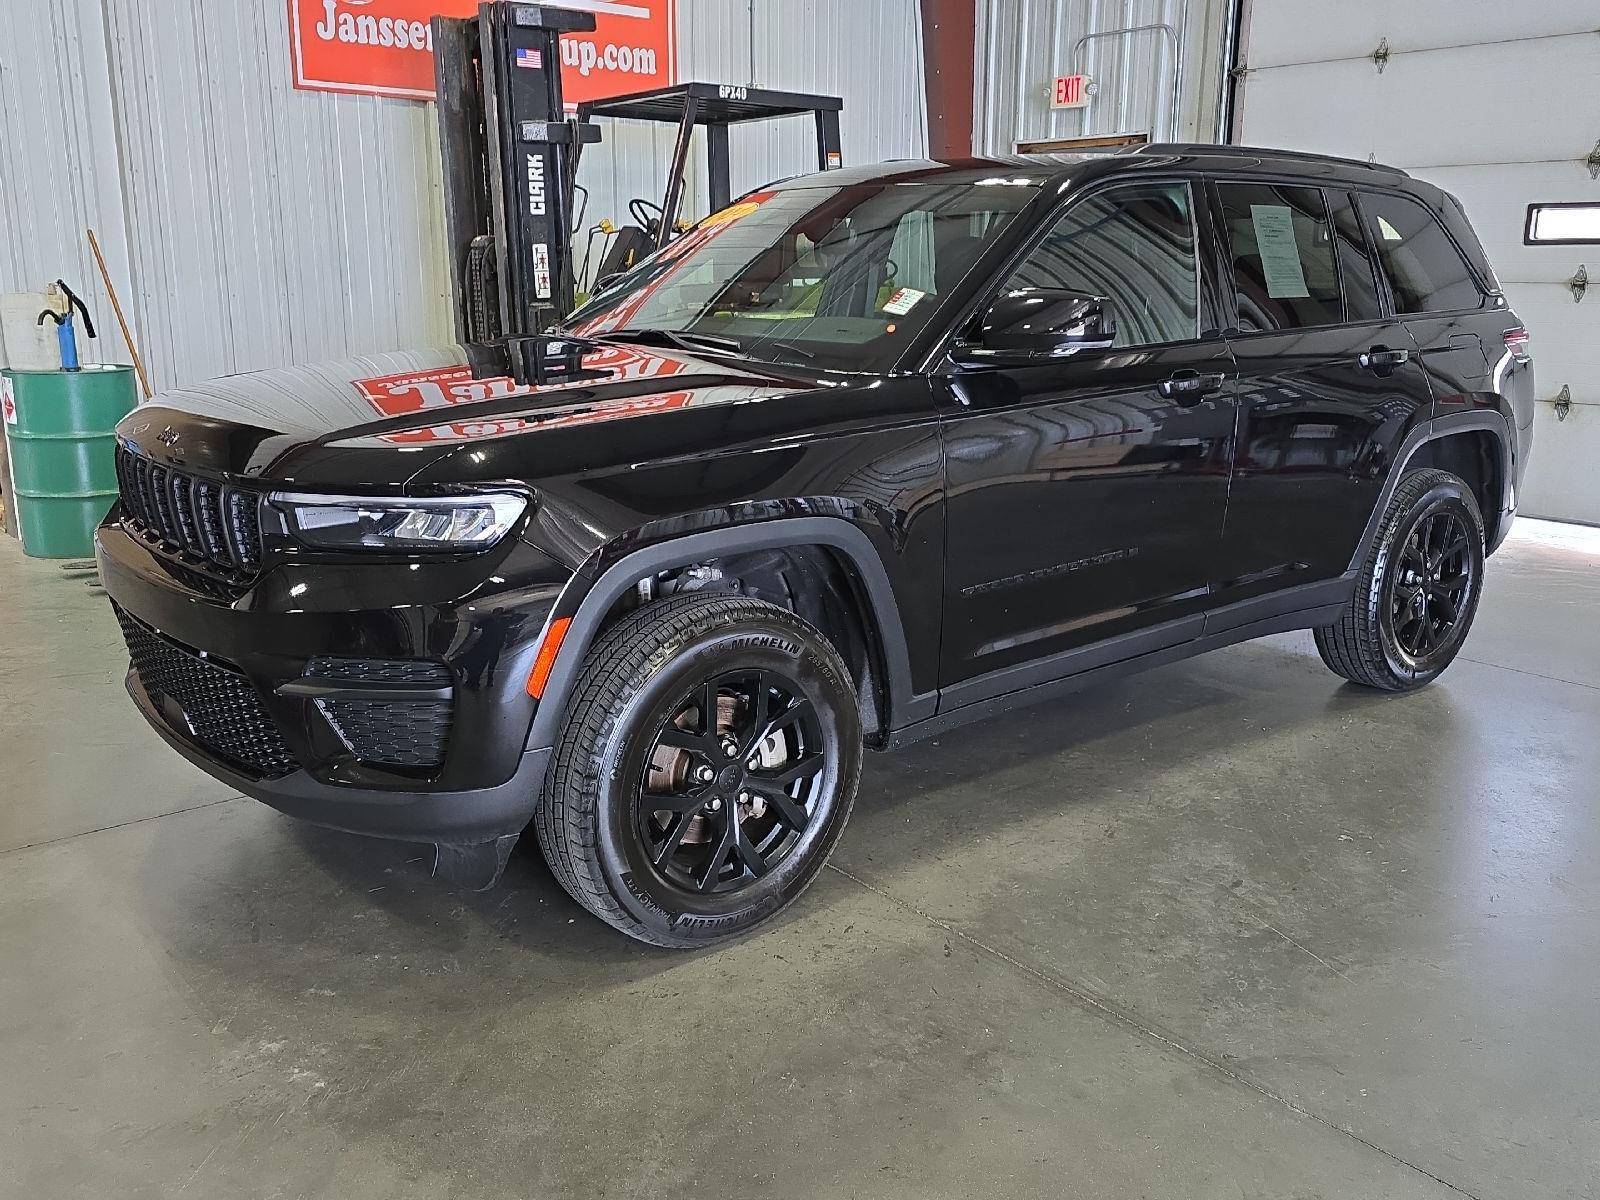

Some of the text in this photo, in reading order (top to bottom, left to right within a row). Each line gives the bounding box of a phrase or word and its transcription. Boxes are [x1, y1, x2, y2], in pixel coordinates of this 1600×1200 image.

[719, 85, 747, 100] GPX40
[1056, 77, 1081, 104] EXIT
[527, 153, 546, 215] CLARK
[731, 636, 801, 655] MICHELIN
